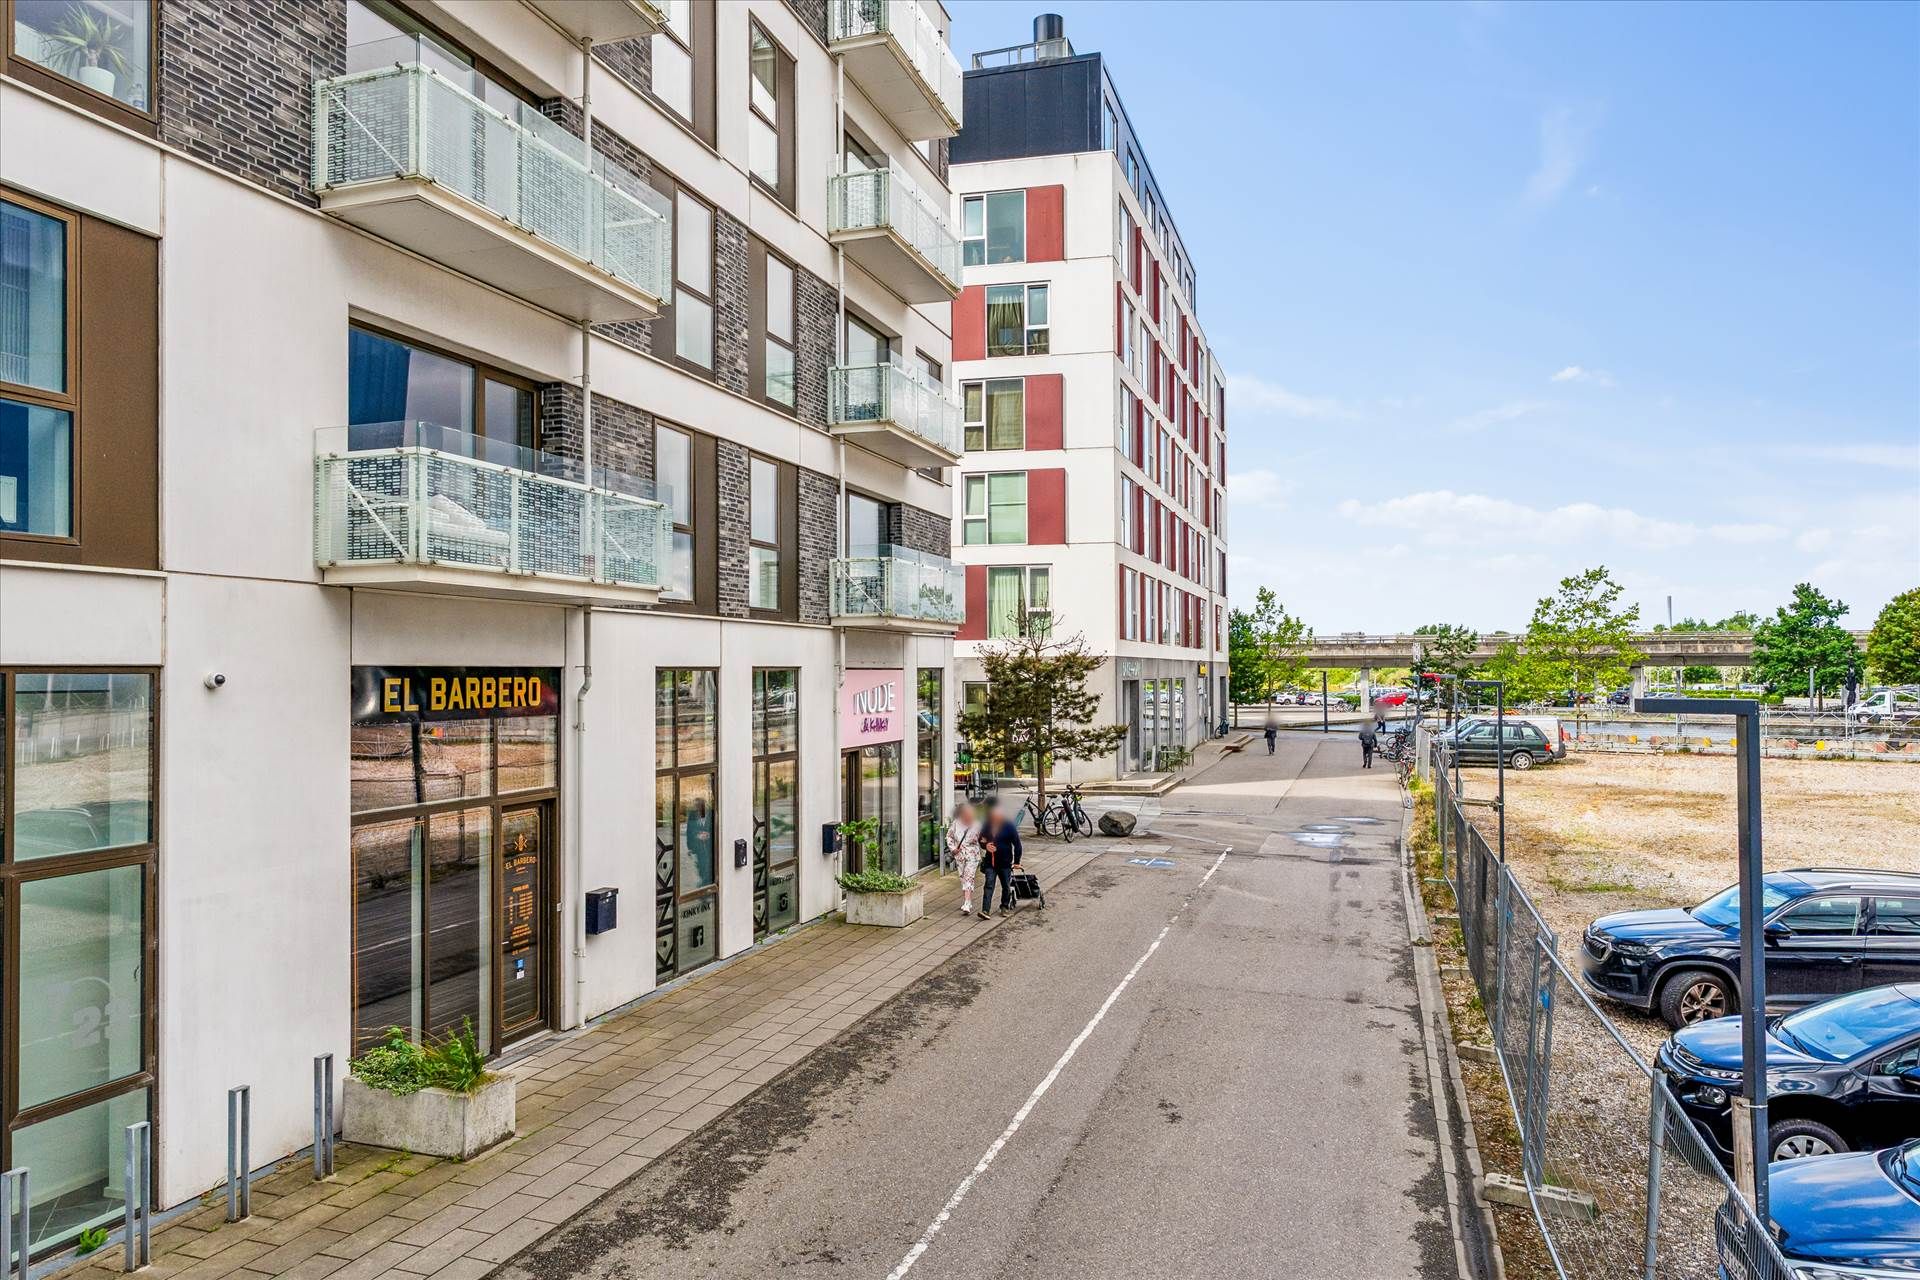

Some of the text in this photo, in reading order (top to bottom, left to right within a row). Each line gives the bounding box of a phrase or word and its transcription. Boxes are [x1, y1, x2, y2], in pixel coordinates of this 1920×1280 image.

[384, 676, 541, 713] EL BARBERO
[854, 681, 896, 715] NUDE
